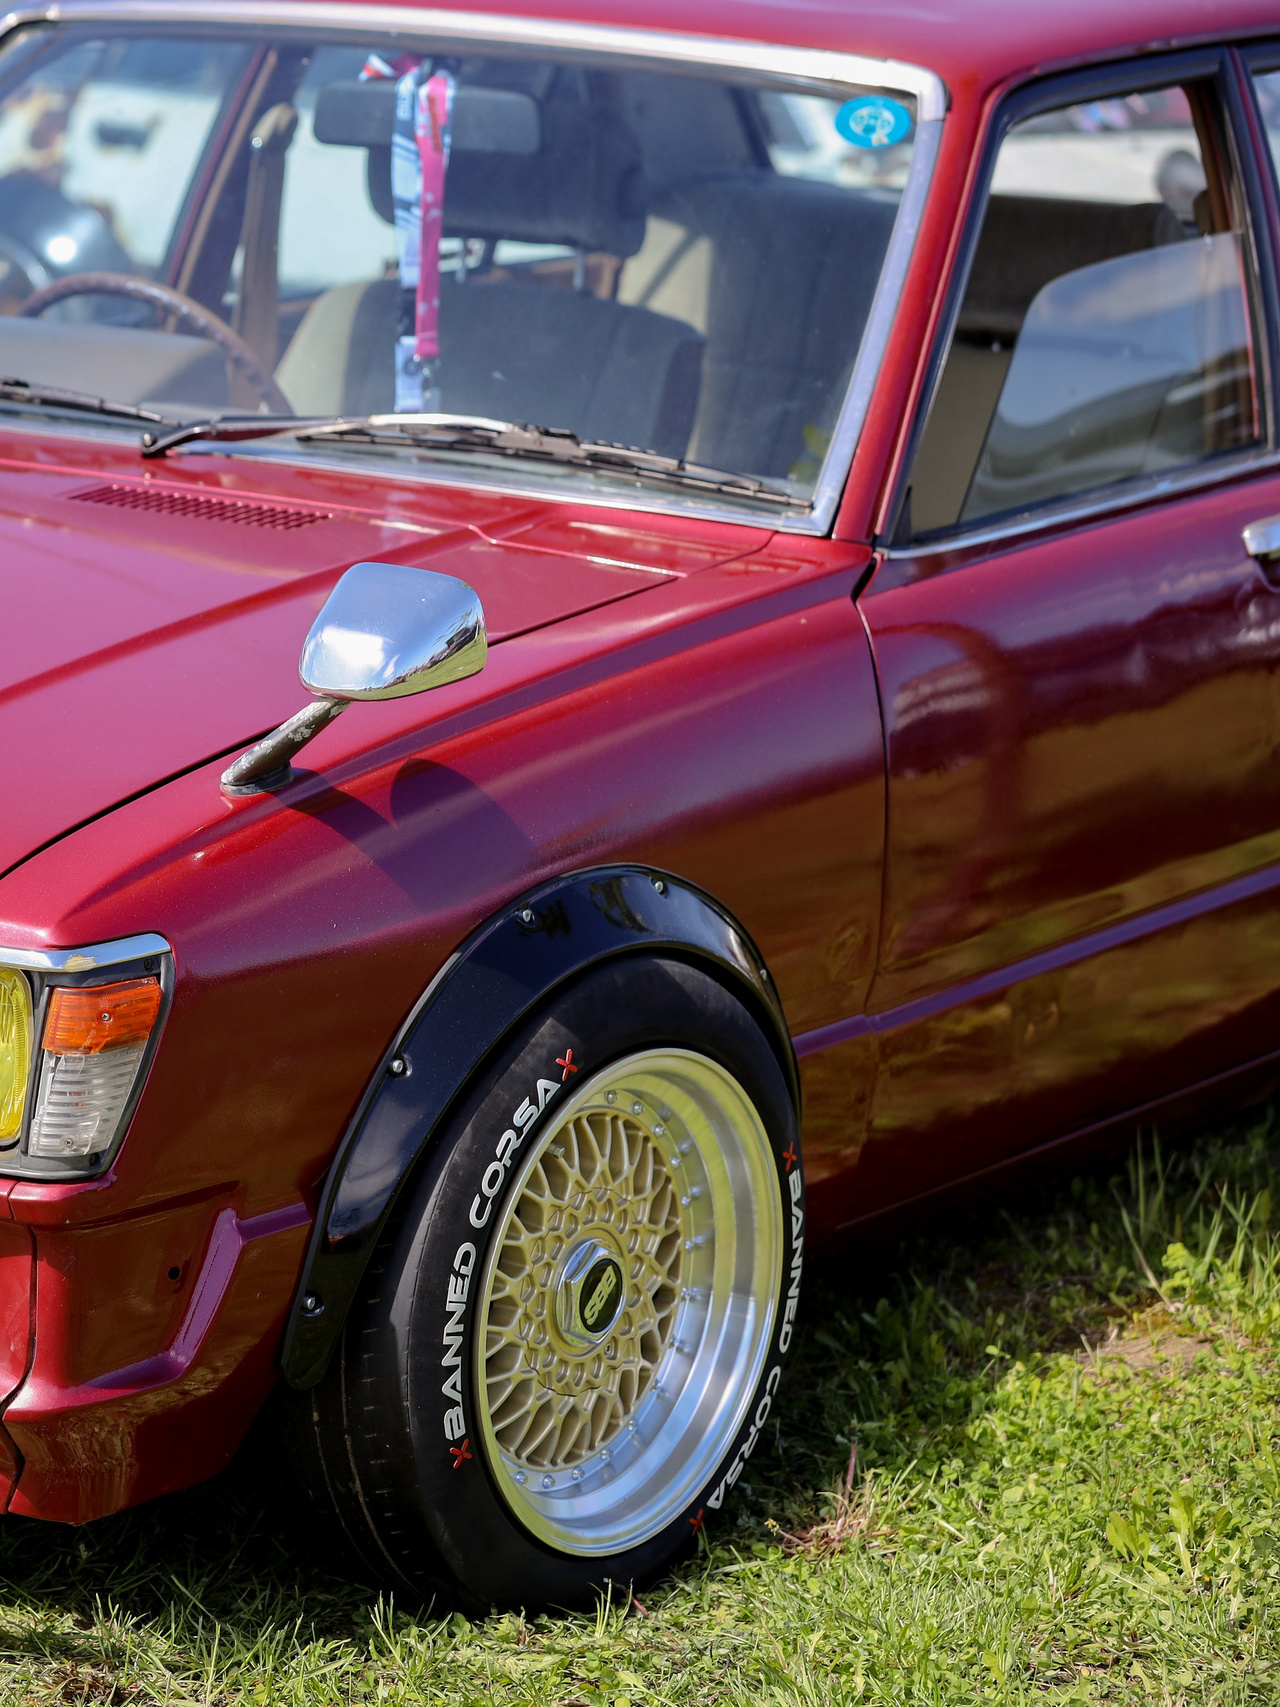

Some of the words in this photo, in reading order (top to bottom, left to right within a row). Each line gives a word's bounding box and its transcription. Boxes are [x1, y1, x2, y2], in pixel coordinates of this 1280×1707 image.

[441, 1242, 477, 1441] BANNED
[470, 1078, 561, 1229] CORSA
[584, 1265, 617, 1326] BBS
[779, 1168, 804, 1354] BANNED
[706, 1365, 781, 1510] CORSA
